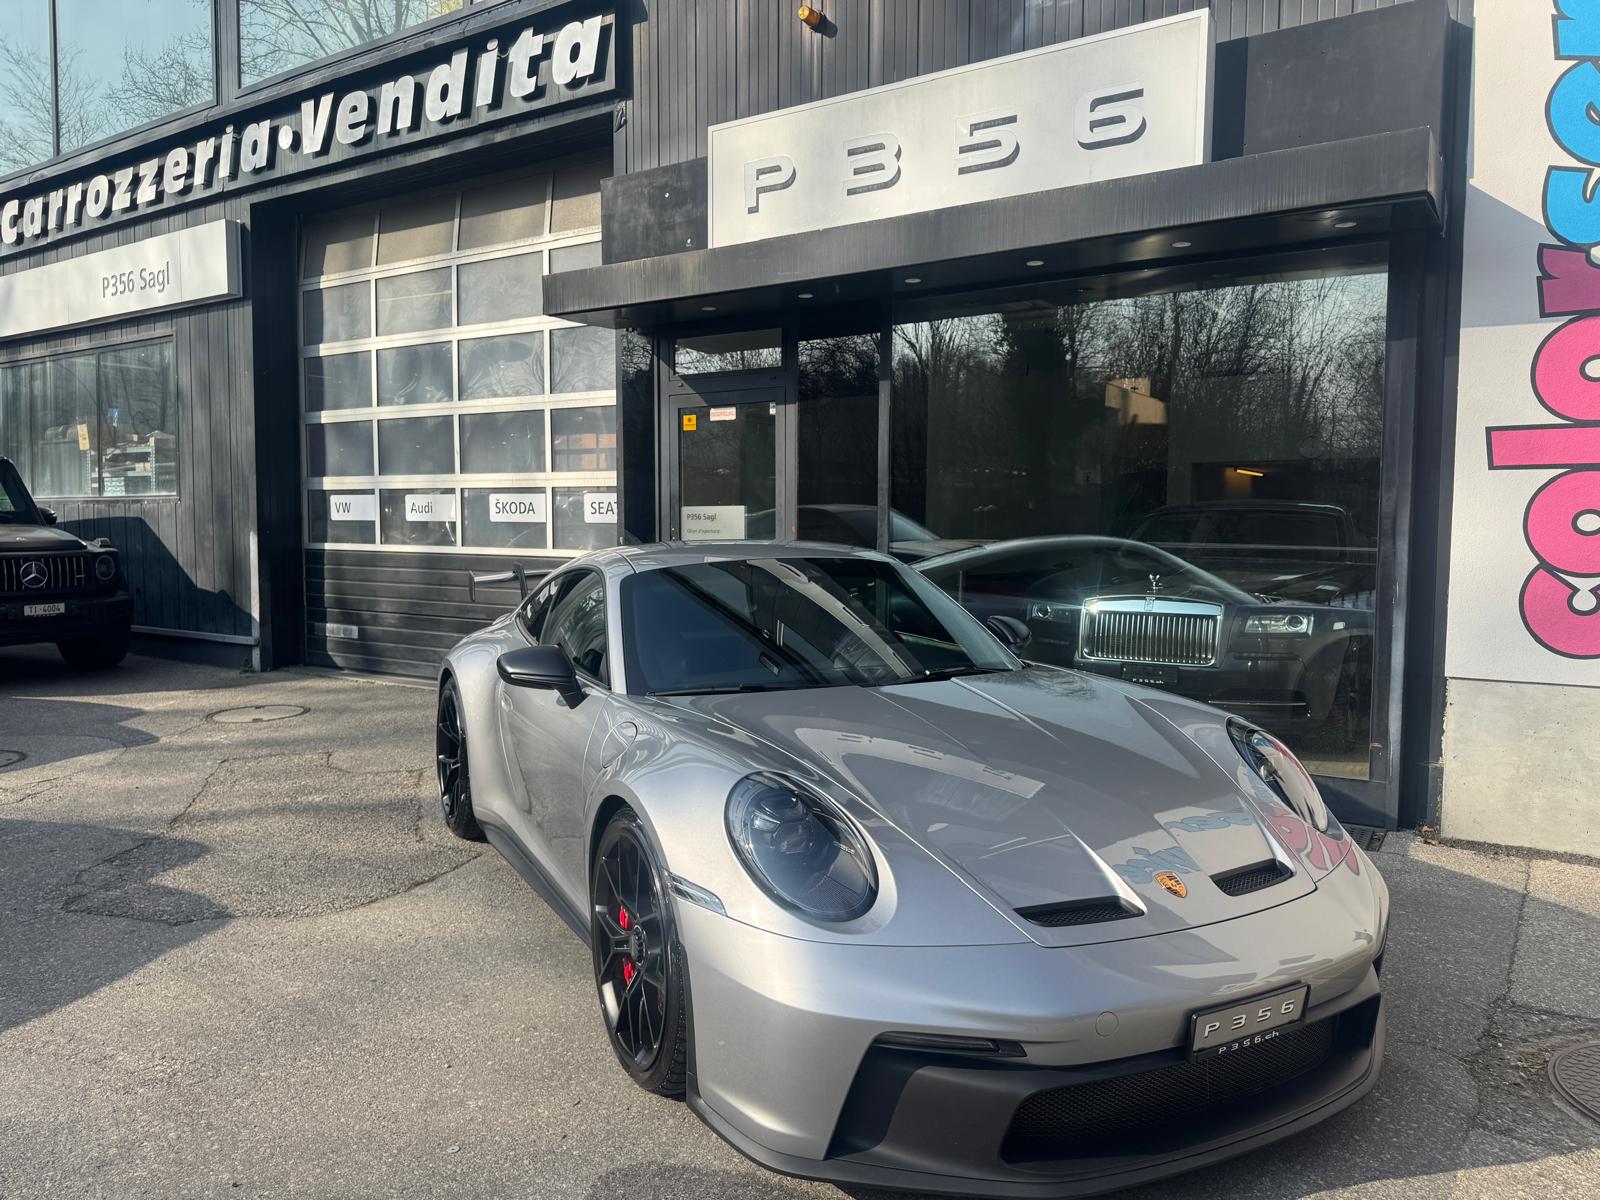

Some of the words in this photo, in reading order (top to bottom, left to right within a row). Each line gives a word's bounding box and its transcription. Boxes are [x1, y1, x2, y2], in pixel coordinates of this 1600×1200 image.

[102, 270, 135, 299] P356
[139, 260, 170, 294] Sagl
[334, 502, 351, 513] VW
[410, 501, 433, 514] Audi
[495, 498, 536, 515] ŠKODA
